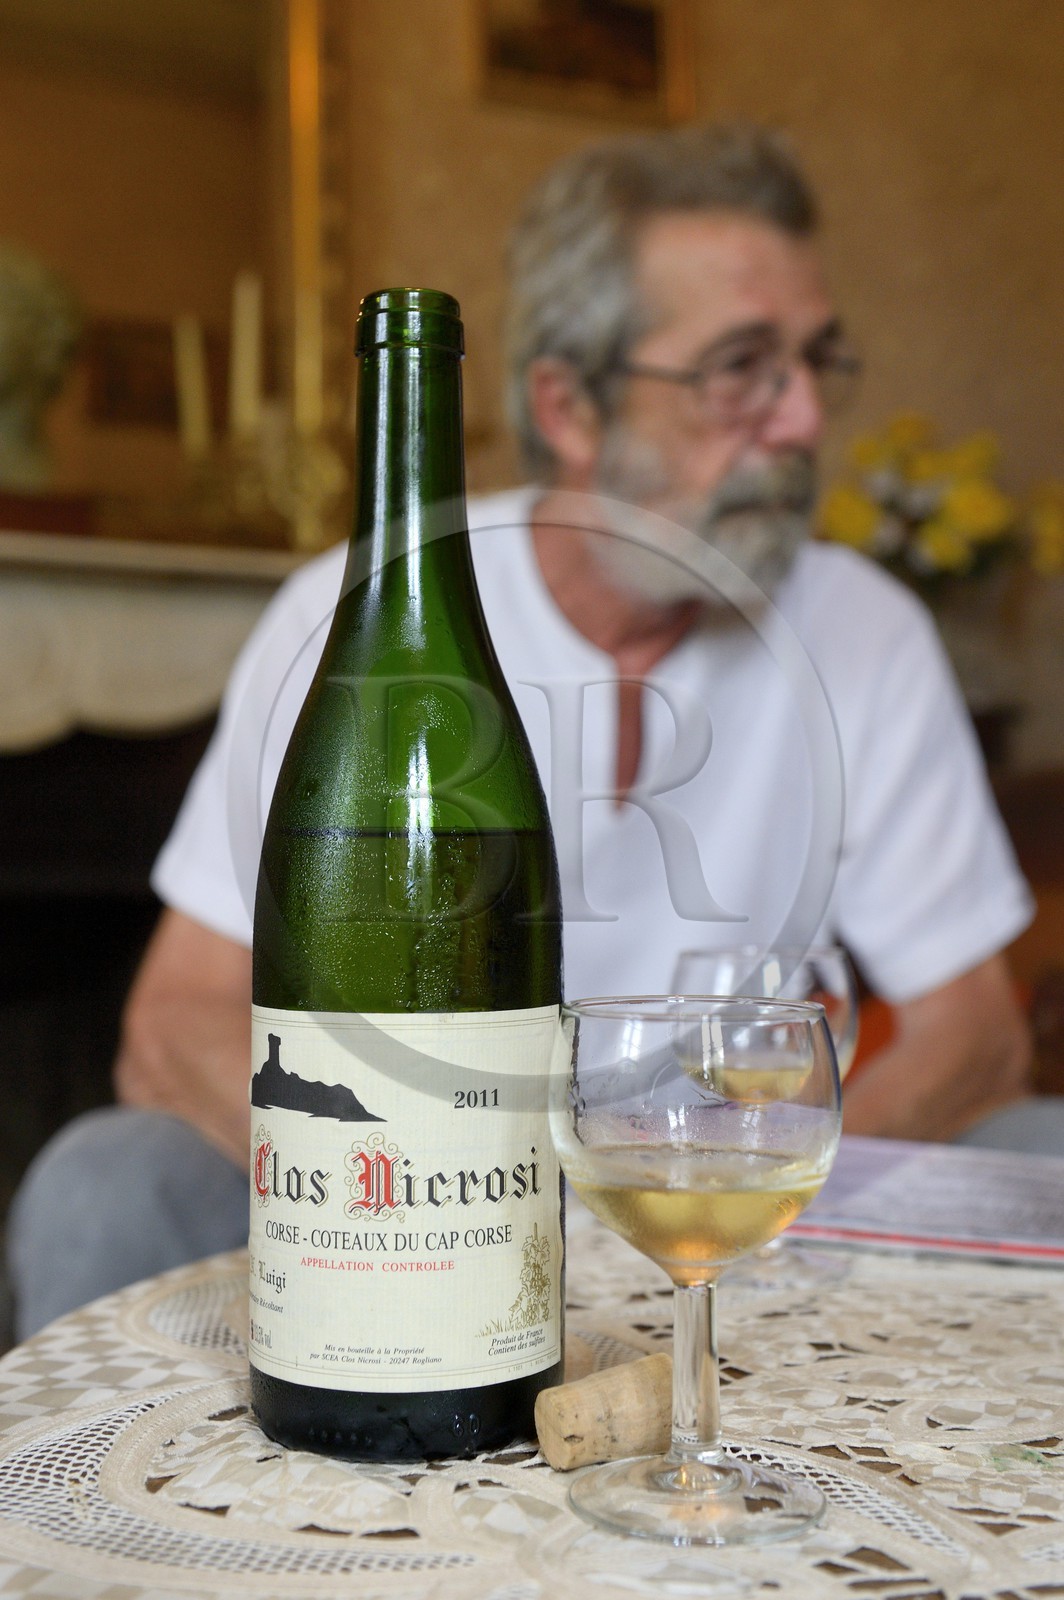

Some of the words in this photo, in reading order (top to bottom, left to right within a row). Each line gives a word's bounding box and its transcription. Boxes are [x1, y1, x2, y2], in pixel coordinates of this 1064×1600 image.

[454, 1088, 500, 1109] 2011
[255, 1142, 333, 1207] Clos
[348, 1146, 541, 1216] Nicrosi
[265, 1220, 300, 1245] CORSE
[311, 1229, 388, 1252] COTEAUX
[394, 1233, 419, 1252] DU
[425, 1231, 459, 1251] CAP
[464, 1224, 513, 1248] CORSE
[300, 1256, 374, 1272] APPELLATION
[381, 1260, 455, 1273] CONTROLEE
[258, 1260, 286, 1294] Luigi
[491, 1335, 516, 1347] Produit
[517, 1332, 525, 1341] de
[324, 1344, 336, 1352] Mis
[347, 1346, 375, 1355] bouteille
[384, 1347, 391, 1355] la
[393, 1346, 425, 1356] Propriété
[488, 1343, 517, 1357] Contient
[517, 1340, 528, 1351] des
[309, 1352, 320, 1361] par
[321, 1353, 339, 1362] SCEA
[341, 1355, 355, 1364] Clos
[357, 1356, 382, 1365] Nicrosi
[389, 1357, 410, 1365] 20247
[412, 1356, 442, 1366] Rogliano
